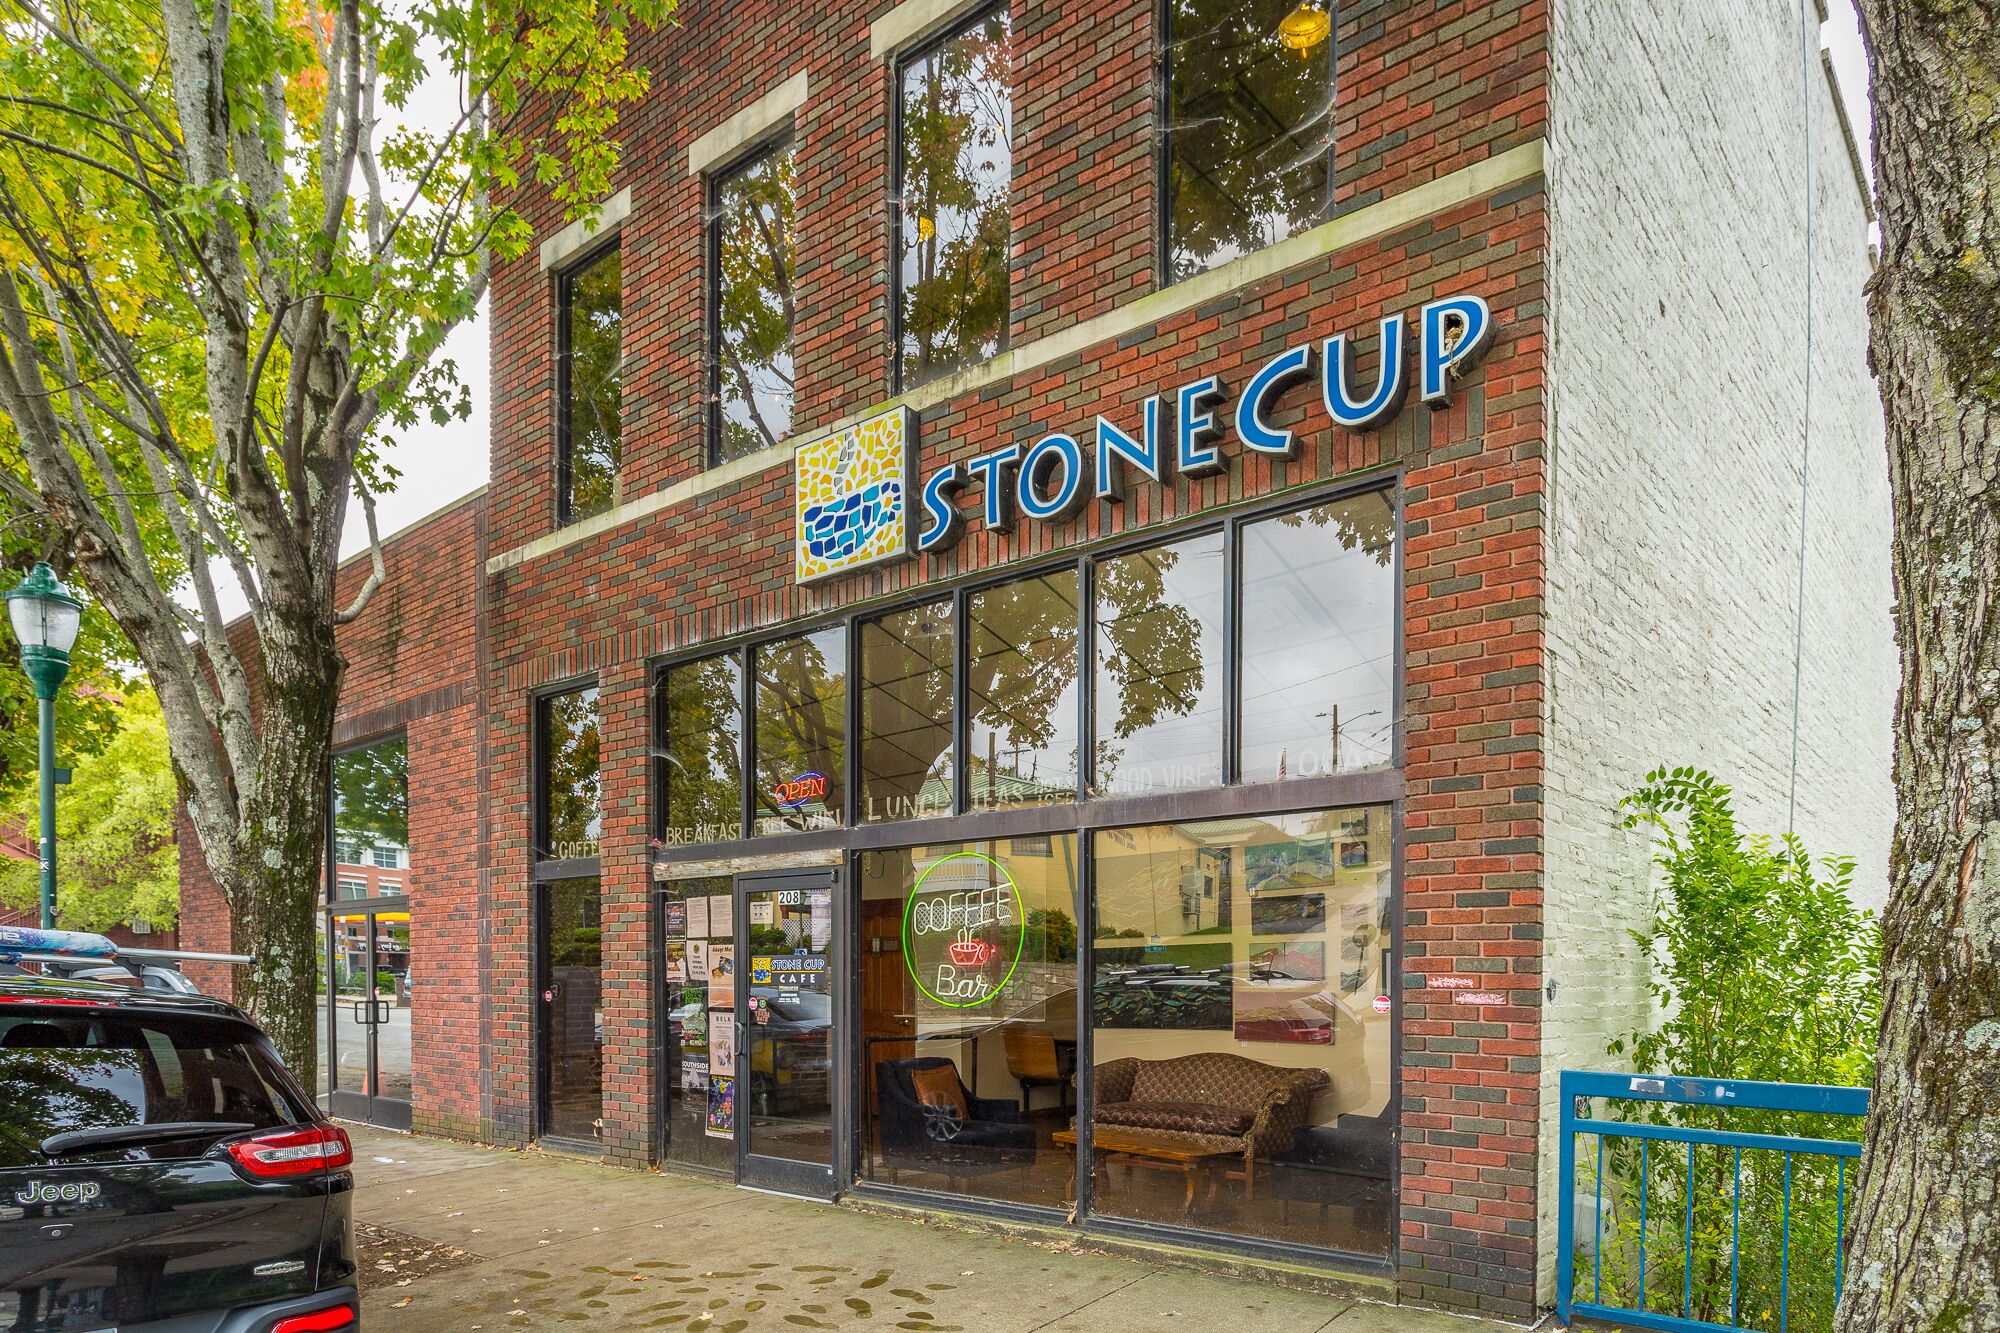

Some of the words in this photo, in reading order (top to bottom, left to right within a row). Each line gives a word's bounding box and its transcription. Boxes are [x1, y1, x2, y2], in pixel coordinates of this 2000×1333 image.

[775, 777, 826, 803] OPEN
[666, 821, 743, 845] BREAKFAST
[559, 840, 601, 860] COFFE
[779, 891, 799, 904] 208
[913, 882, 1013, 935] COFFEE
[771, 959, 802, 970] STONE
[803, 958, 825, 970] CUP
[779, 973, 816, 983] CAFE
[936, 964, 994, 1000] Bar
[681, 1060, 709, 1070] SOUTHSIDE
[16, 1180, 100, 1204] Jeep
